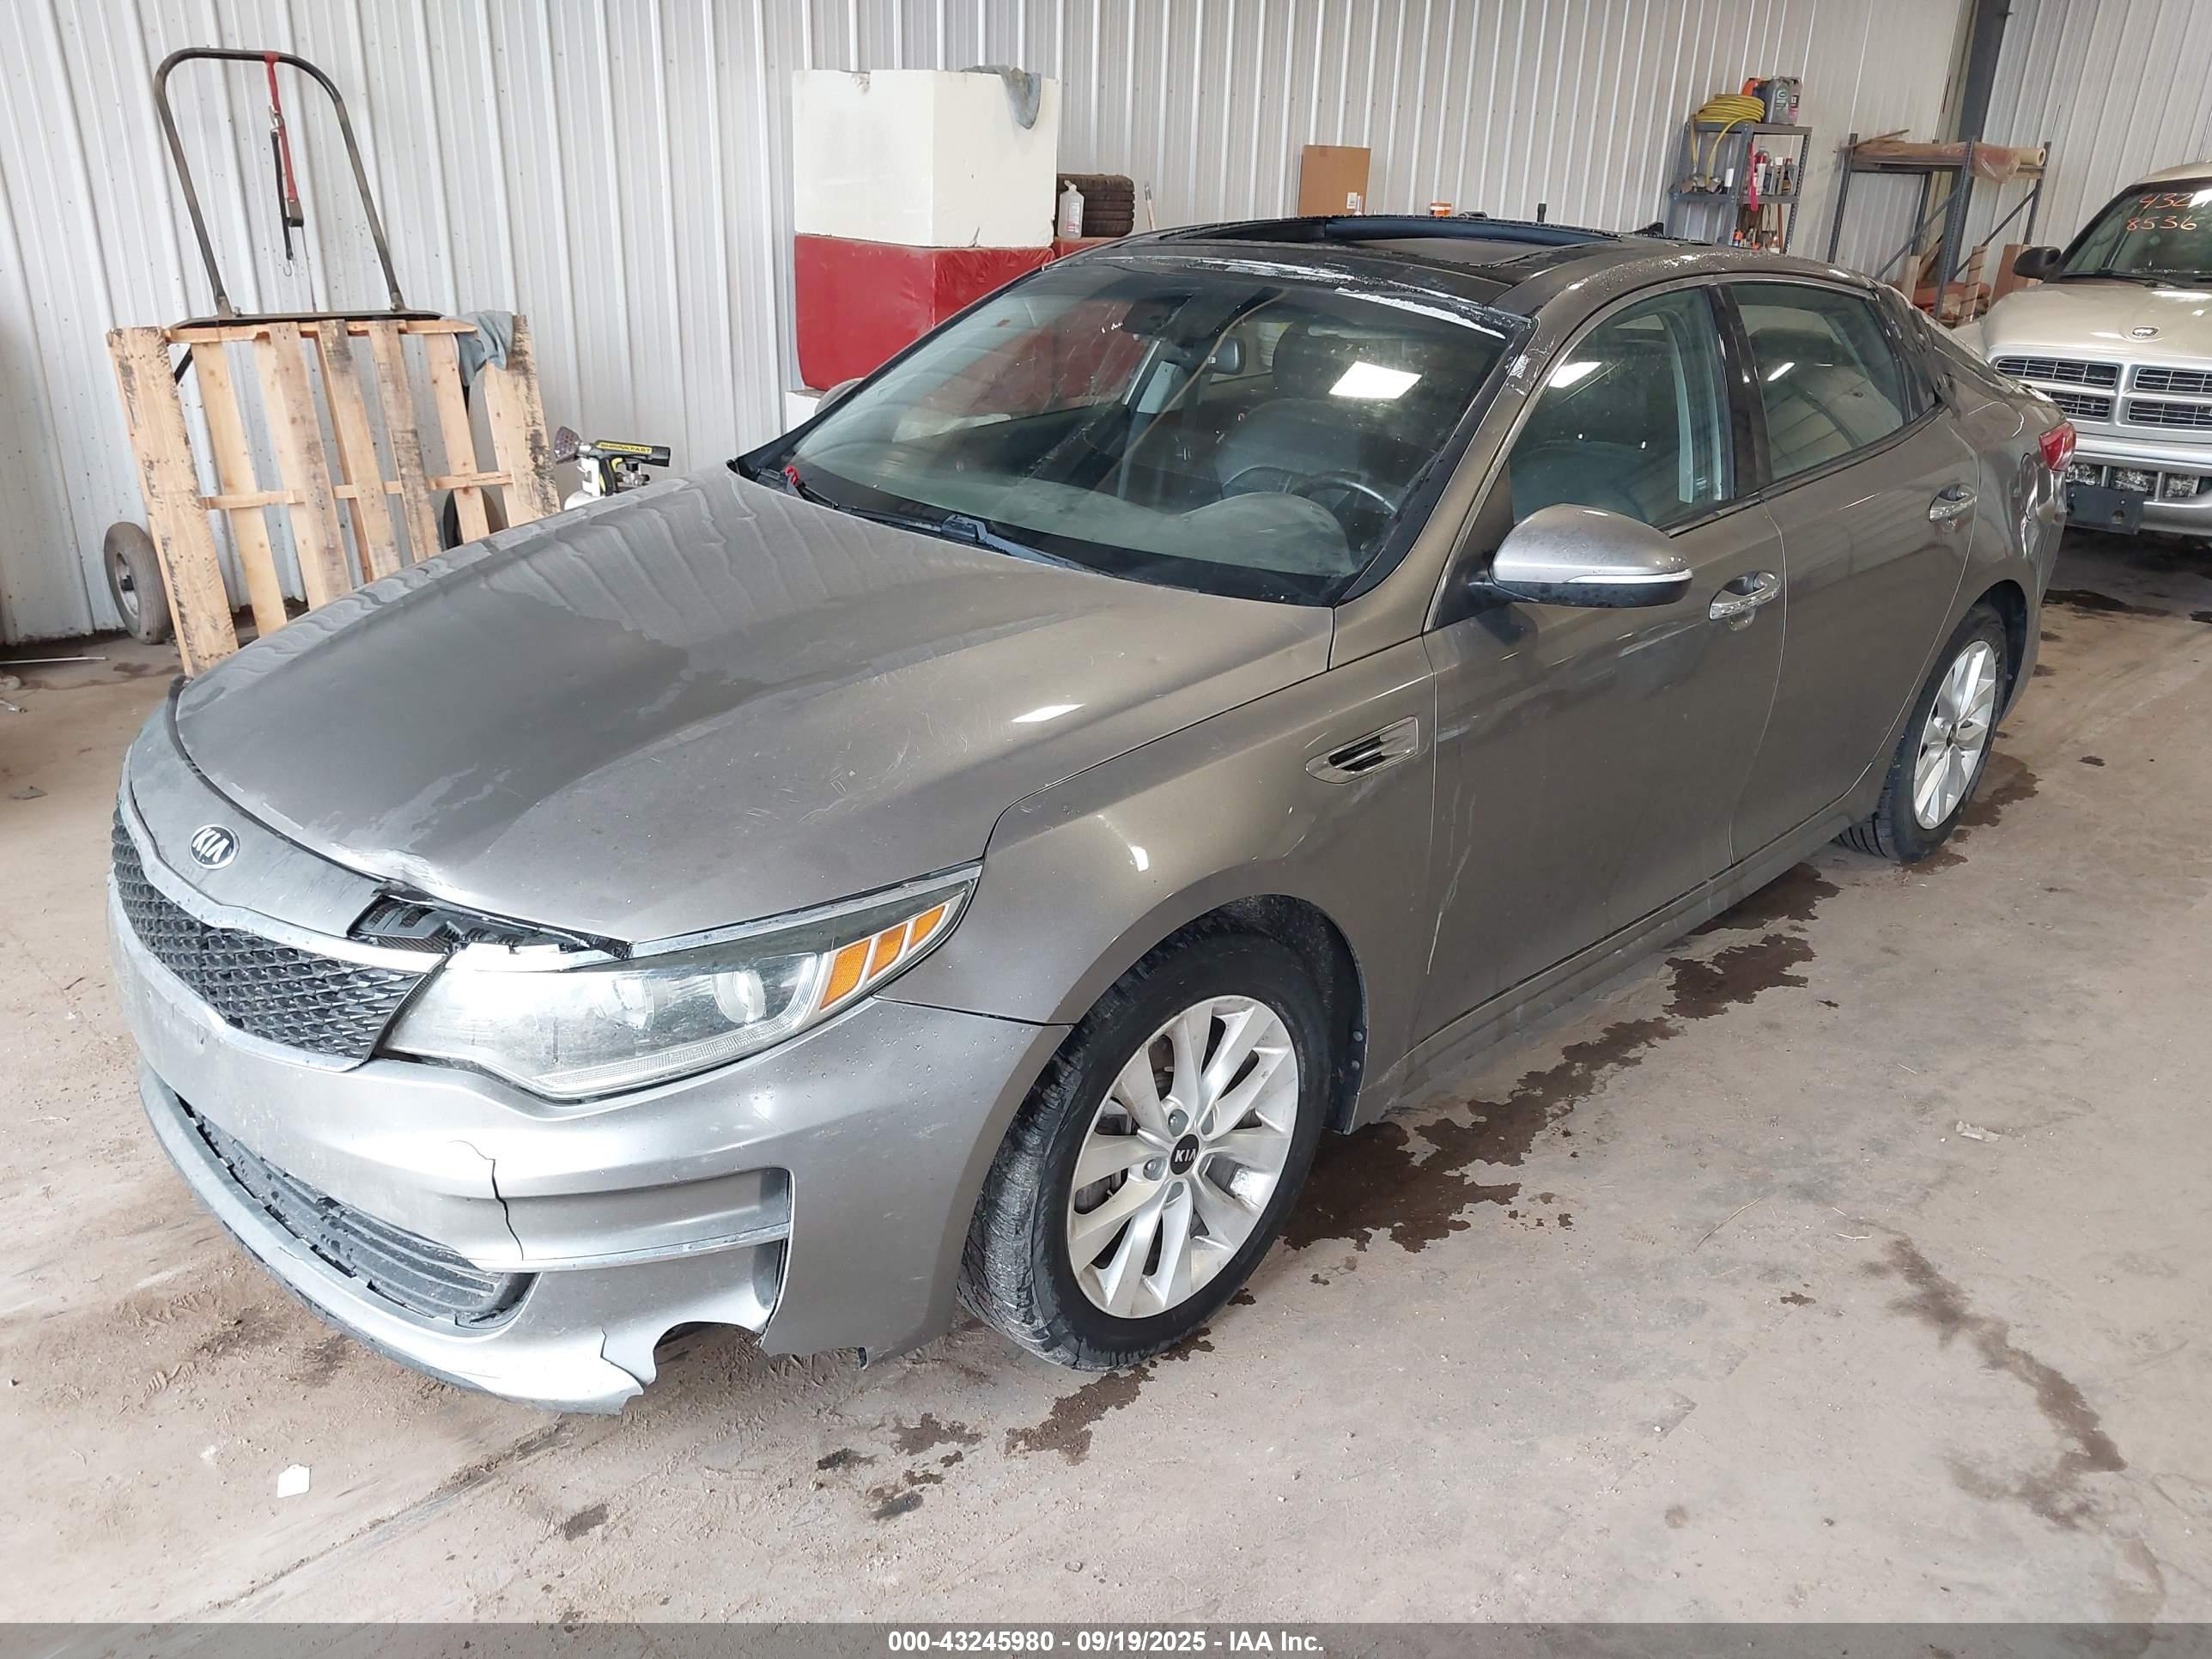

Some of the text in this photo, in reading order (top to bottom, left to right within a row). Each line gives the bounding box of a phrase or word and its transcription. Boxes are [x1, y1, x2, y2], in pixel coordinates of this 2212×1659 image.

[2139, 191, 2209, 210] 432
[2126, 215, 2197, 231] 8536
[191, 828, 230, 863] KIA
[1174, 1148, 1196, 1163] KIA
